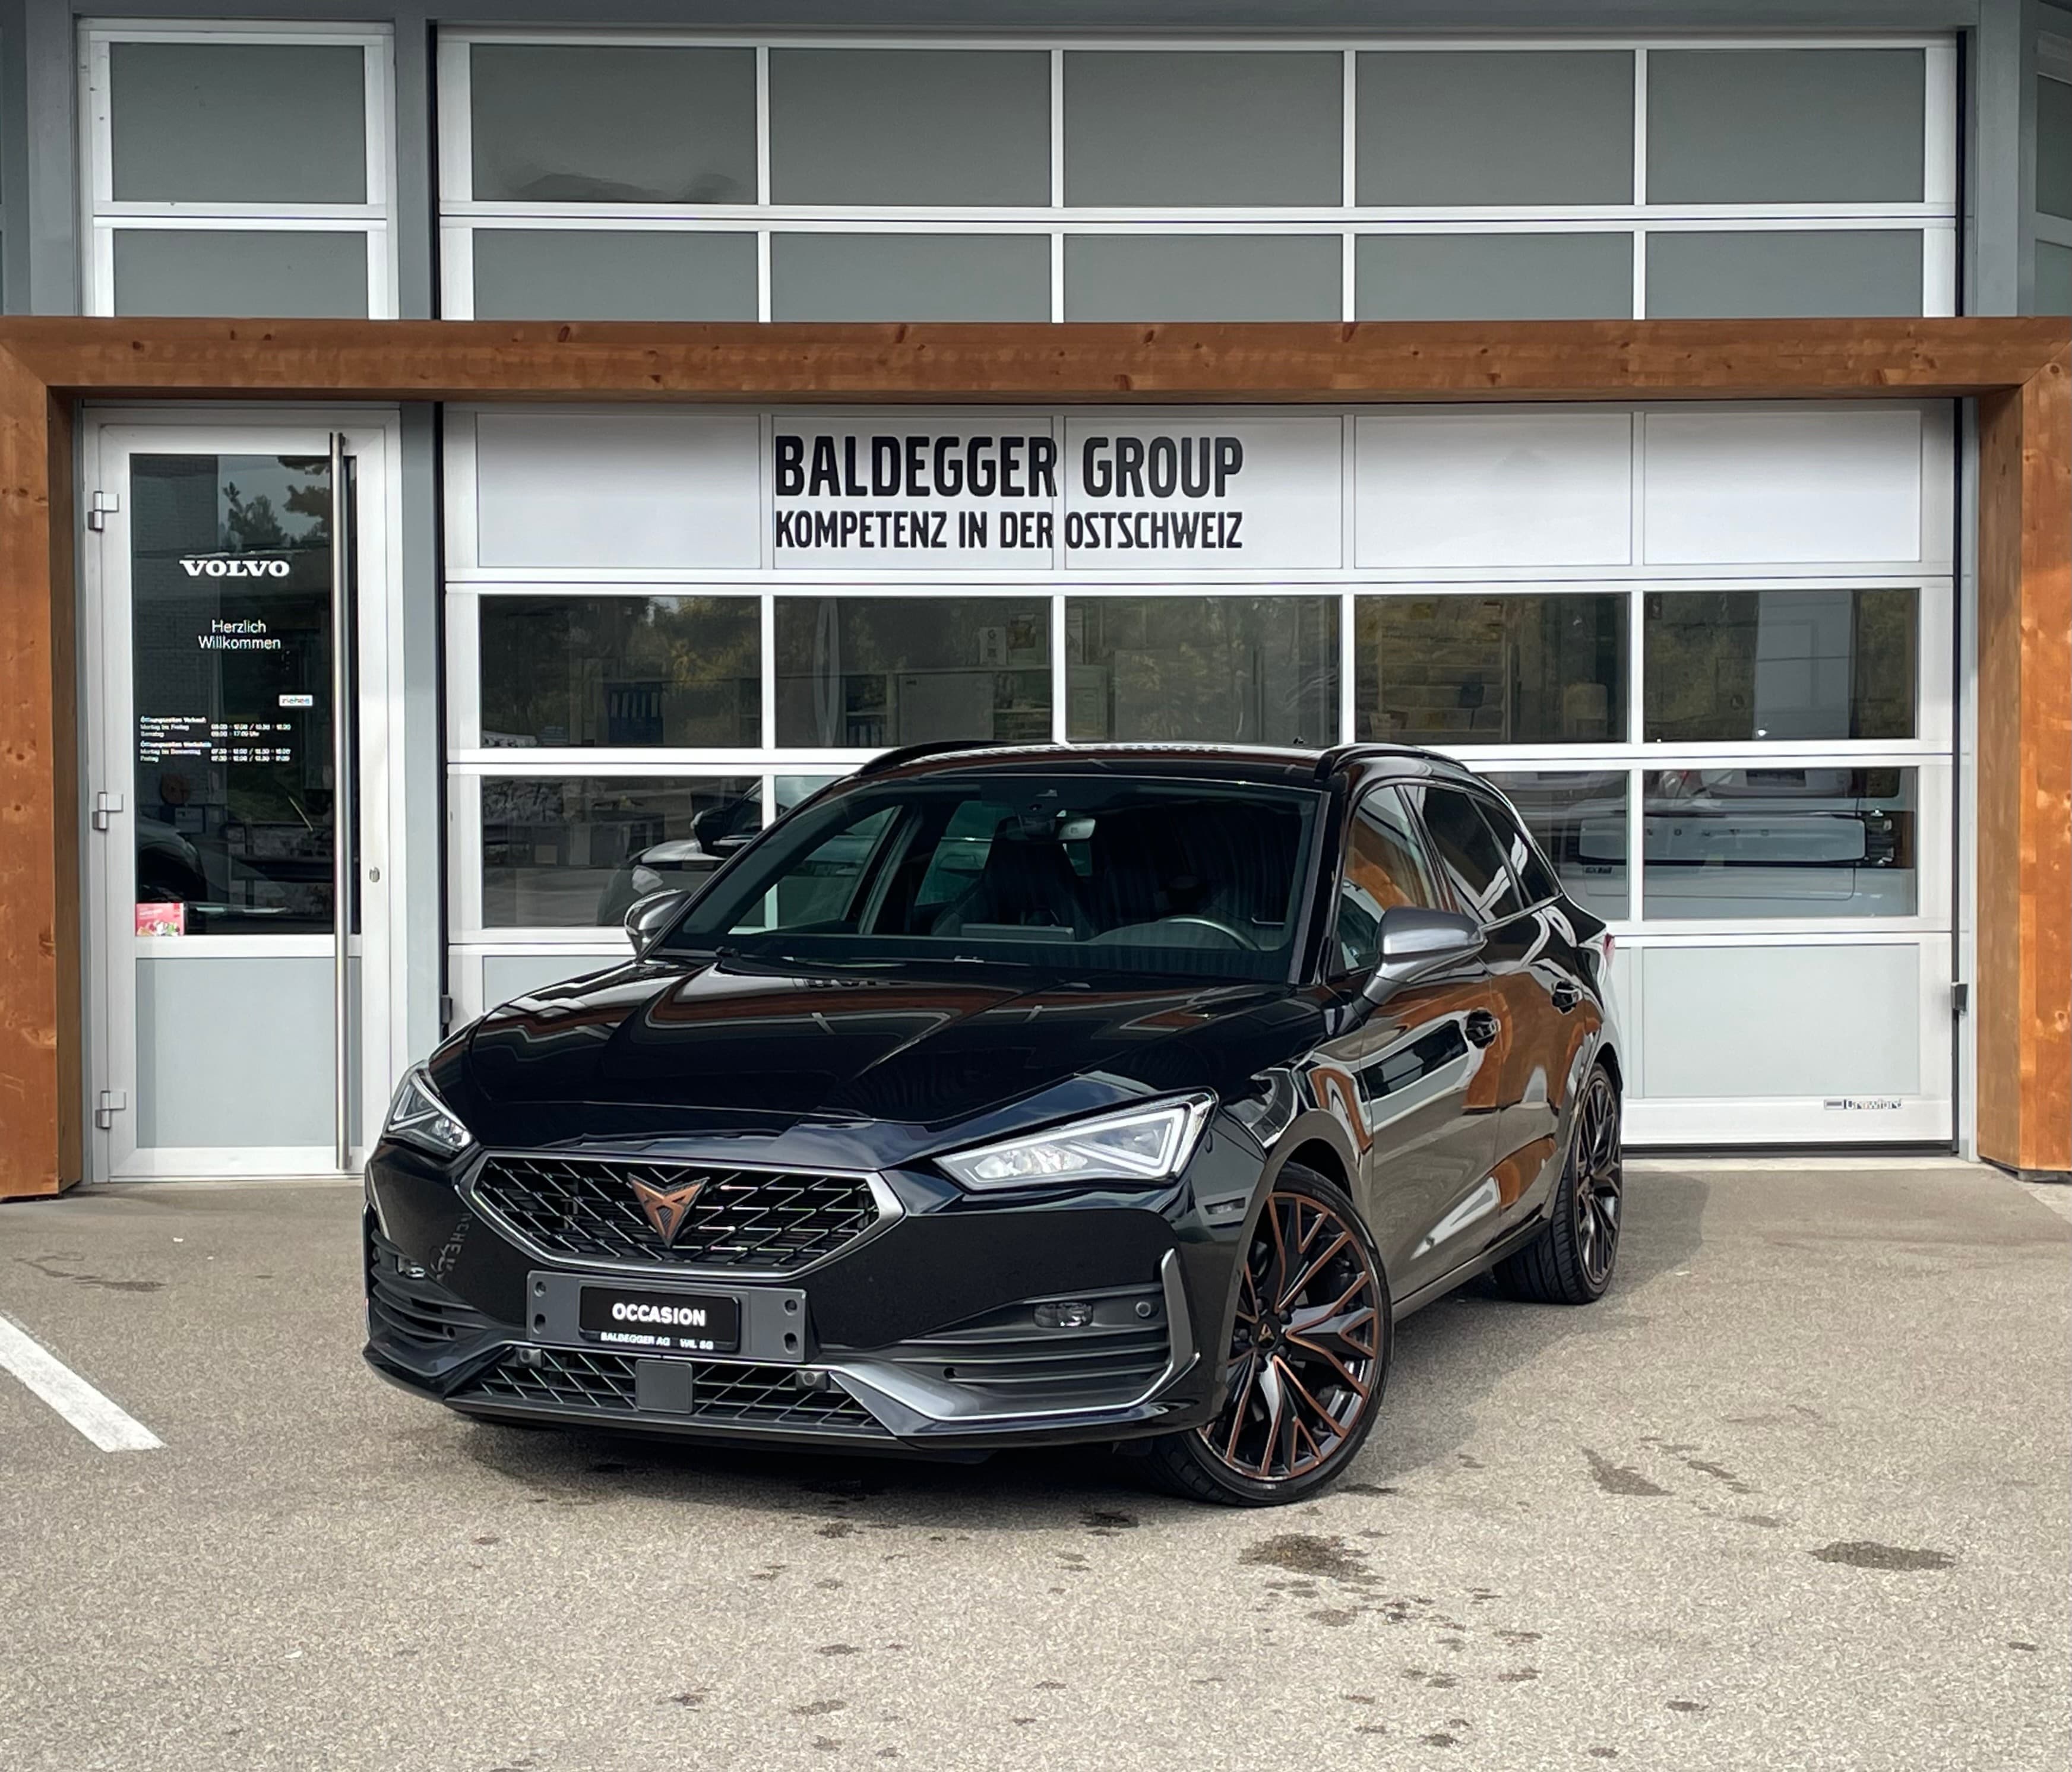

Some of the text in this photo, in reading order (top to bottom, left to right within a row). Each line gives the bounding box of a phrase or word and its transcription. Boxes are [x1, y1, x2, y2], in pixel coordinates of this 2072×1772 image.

[775, 436, 1242, 498] BALDEGGER GROUP
[776, 511, 1242, 549] KOMPETENZ IN DER OSTSCHWEIZ
[179, 560, 290, 577] VOLVO
[211, 619, 267, 634] Herzlich
[198, 635, 281, 650] Willkommen
[612, 1302, 706, 1327] OCCASION
[600, 1332, 654, 1345] BALDEGGER
[656, 1337, 670, 1346] AG
